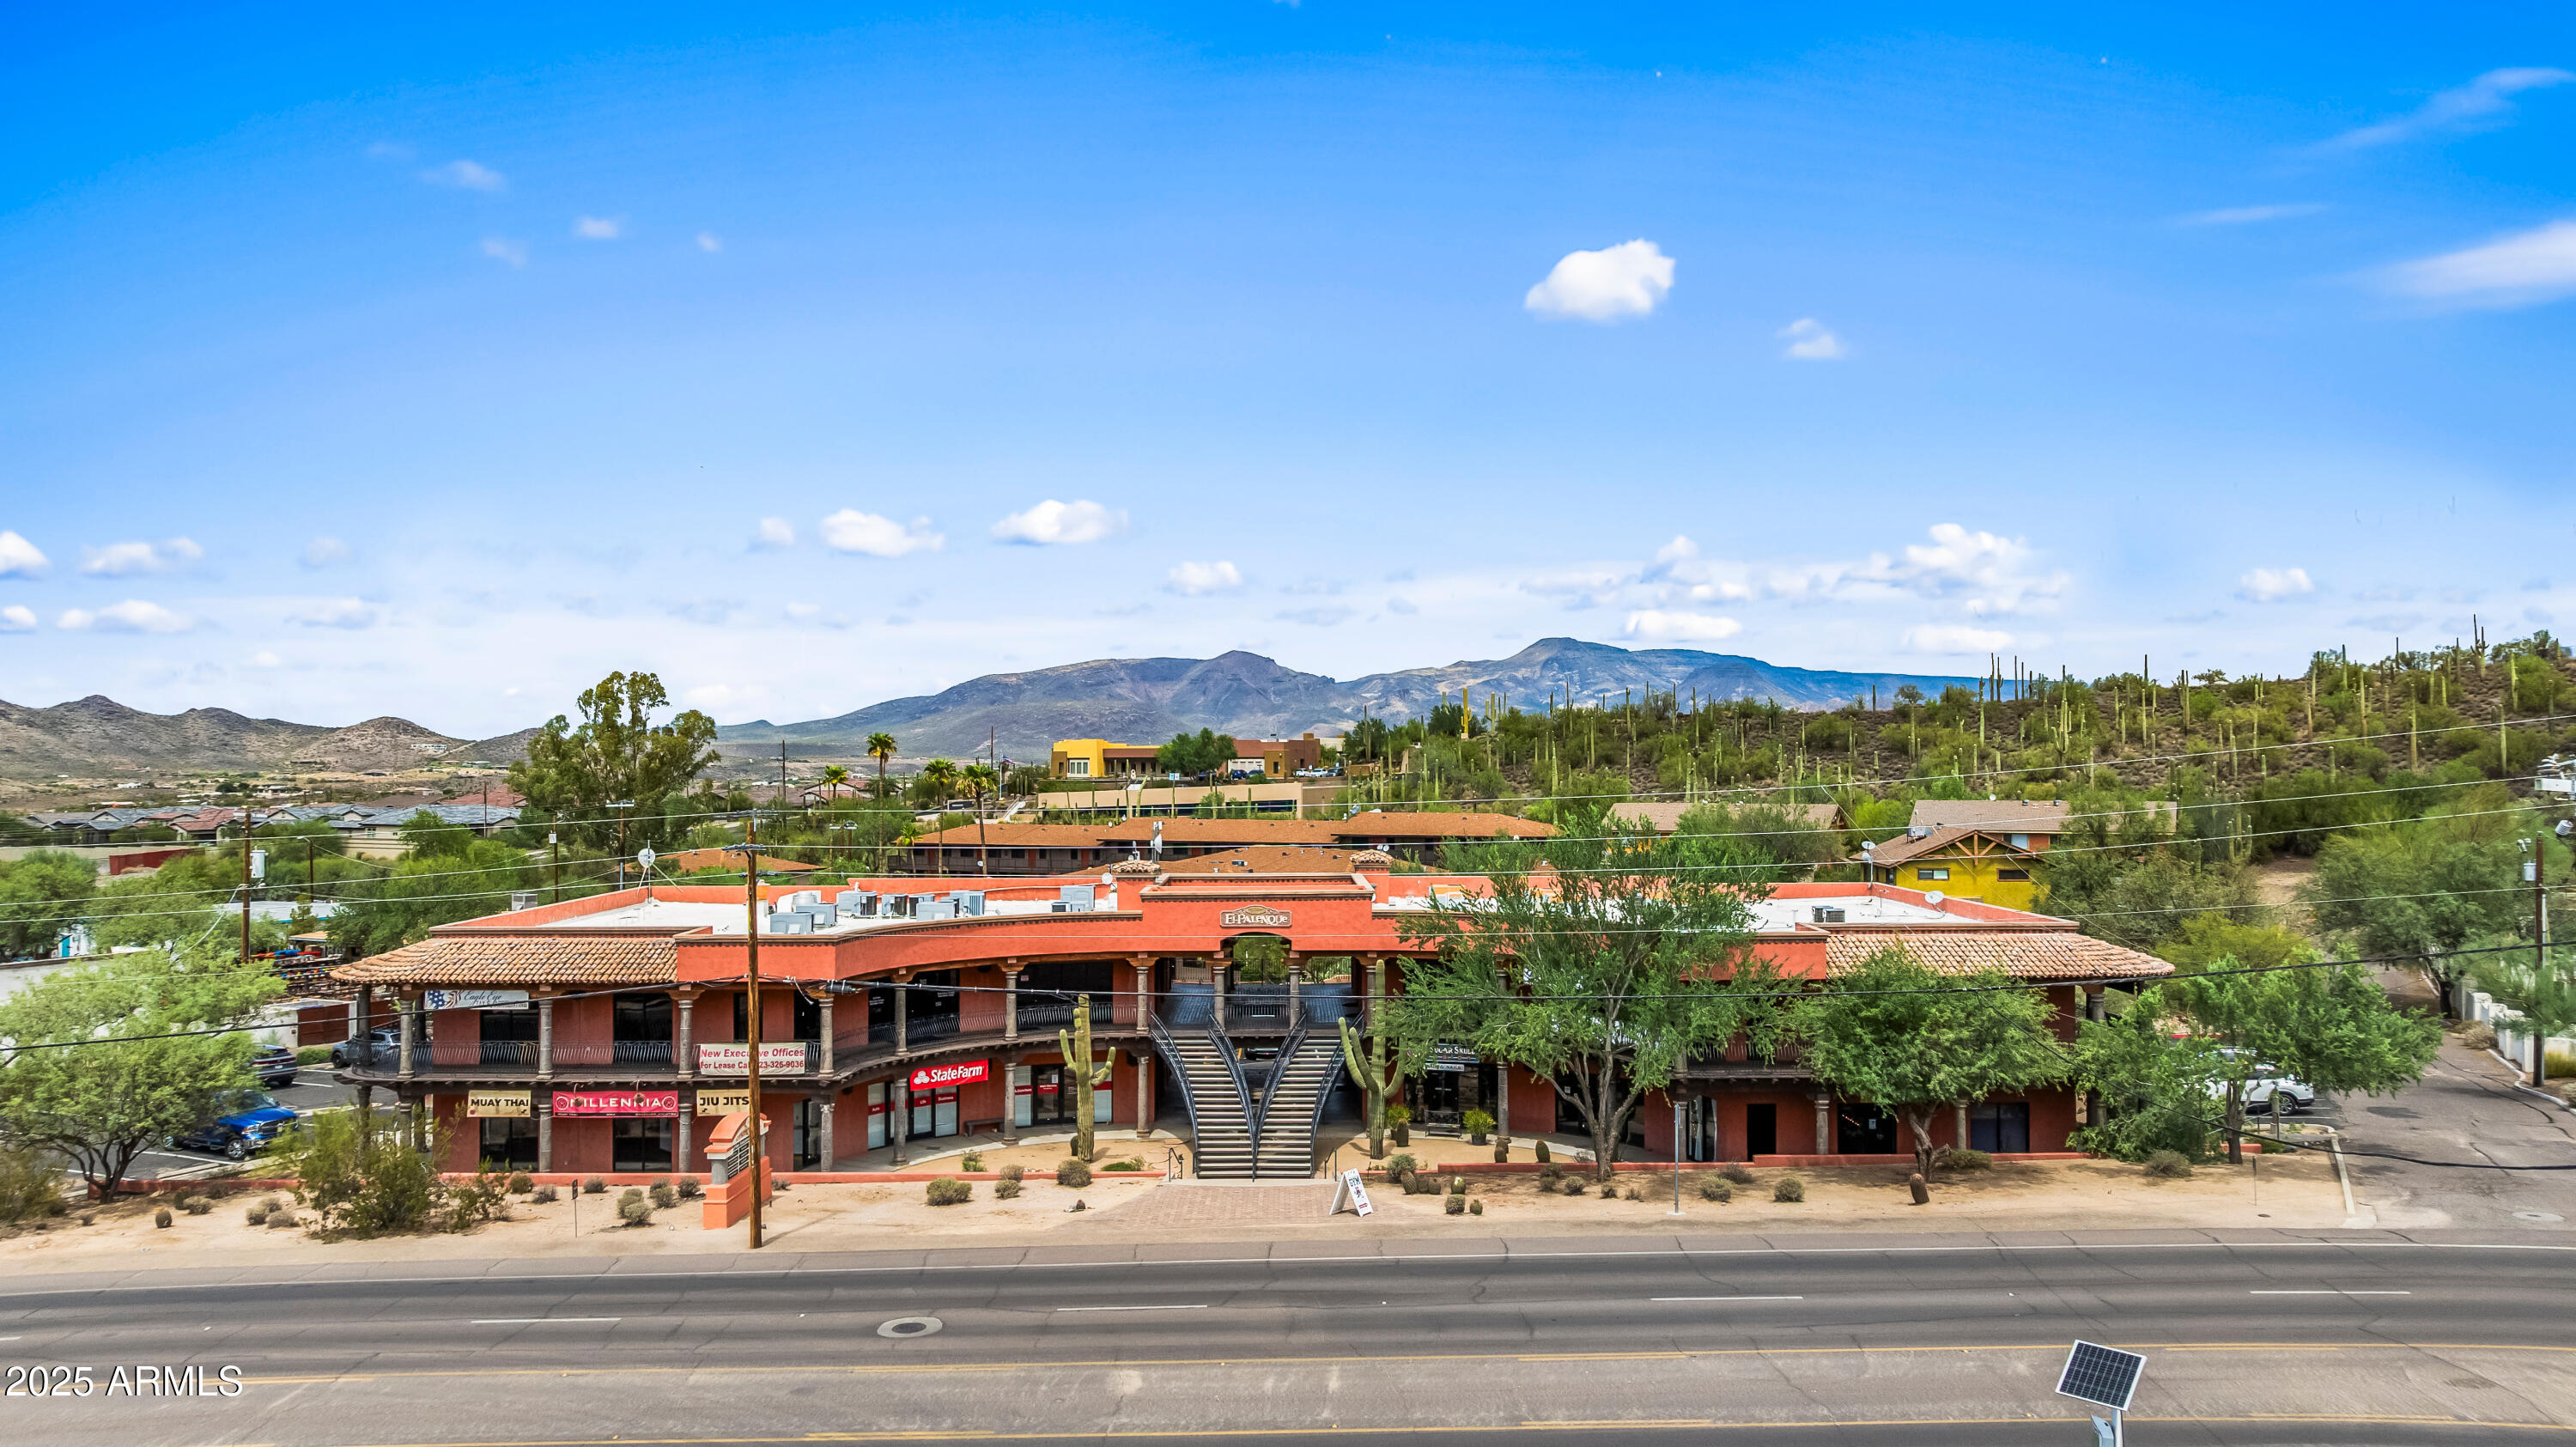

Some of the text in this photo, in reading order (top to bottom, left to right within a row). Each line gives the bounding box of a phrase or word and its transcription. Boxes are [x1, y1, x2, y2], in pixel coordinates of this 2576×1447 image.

[464, 990, 486, 1005] Eagle
[487, 990, 502, 1004] Eye
[724, 1049, 769, 1057] Execve
[772, 1048, 805, 1056] Offices
[758, 1060, 805, 1068] 23-326-9036
[699, 1096, 750, 1106] JIU JITS
